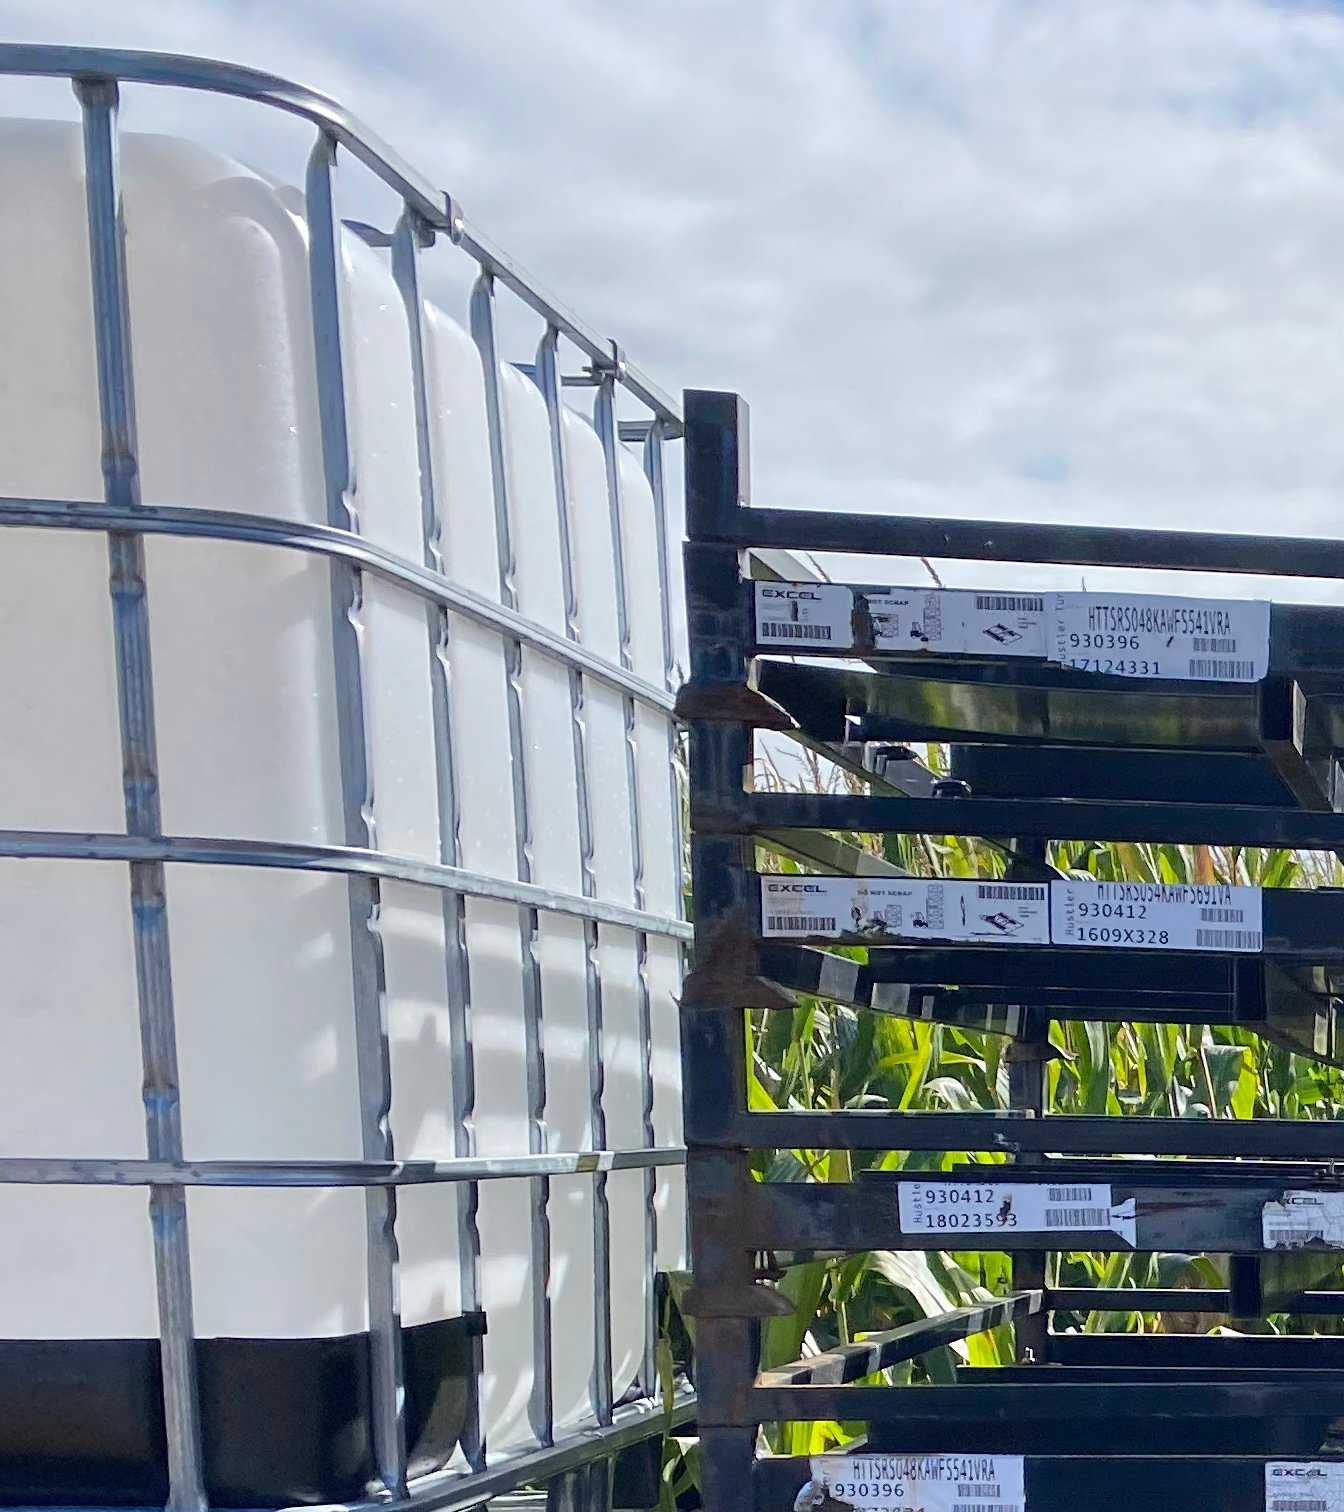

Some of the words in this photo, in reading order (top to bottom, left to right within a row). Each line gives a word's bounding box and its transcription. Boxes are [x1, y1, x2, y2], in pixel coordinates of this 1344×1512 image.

[761, 588, 823, 601] EXCEL
[1069, 633, 1140, 650] 930396
[1070, 657, 1161, 676] 17124331
[767, 883, 828, 894] EXCEL
[1064, 888, 1076, 937] Hustler
[1077, 902, 1148, 920] 930412
[1077, 926, 1169, 945] 1609X328
[925, 1189, 995, 1204] 930412
[925, 1213, 1018, 1229] 18023593
[1271, 1468, 1328, 1478] EXCEL
[834, 1483, 905, 1498] 930396
